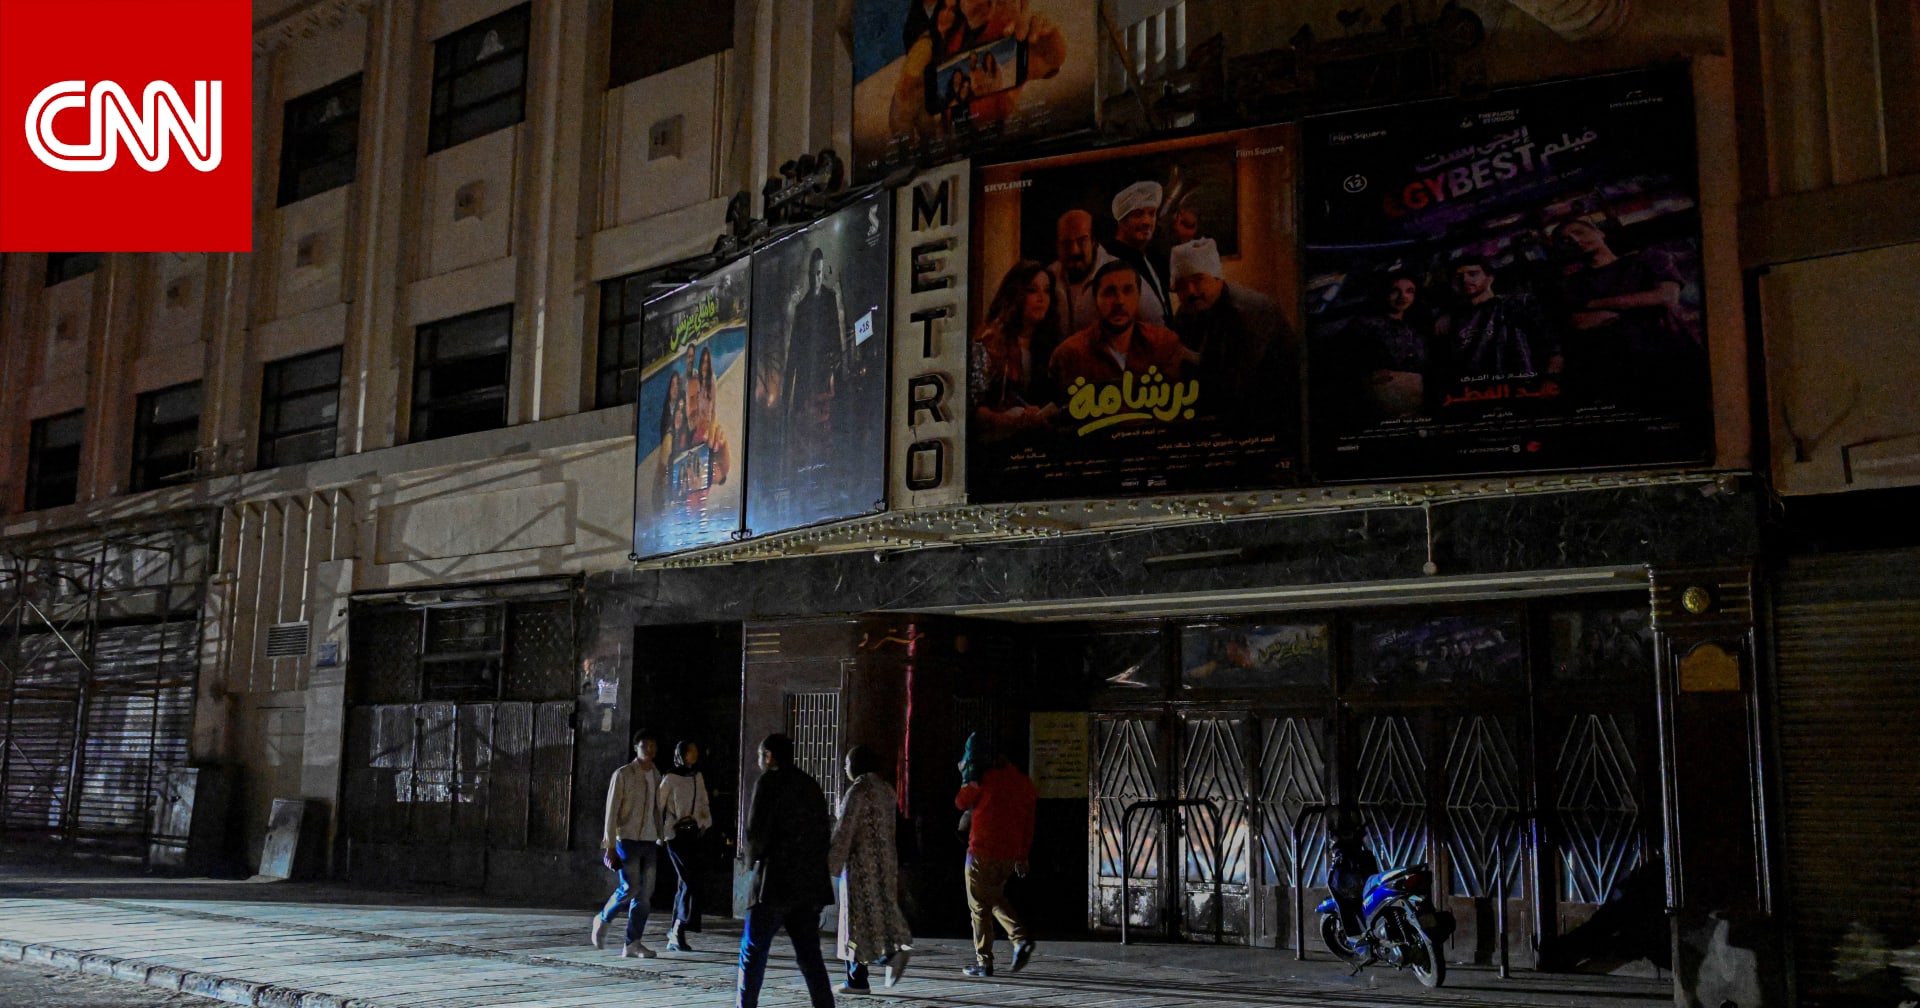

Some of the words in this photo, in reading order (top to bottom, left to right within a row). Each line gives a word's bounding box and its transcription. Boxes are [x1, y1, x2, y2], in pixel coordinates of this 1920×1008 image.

[1540, 126, 1598, 168] فيلم
[859, 320, 870, 333] +18
[906, 177, 953, 491] METRO
[1067, 365, 1199, 421] برشامة
[1441, 384, 1511, 406] الفطر
[1514, 381, 1561, 400] عيد
